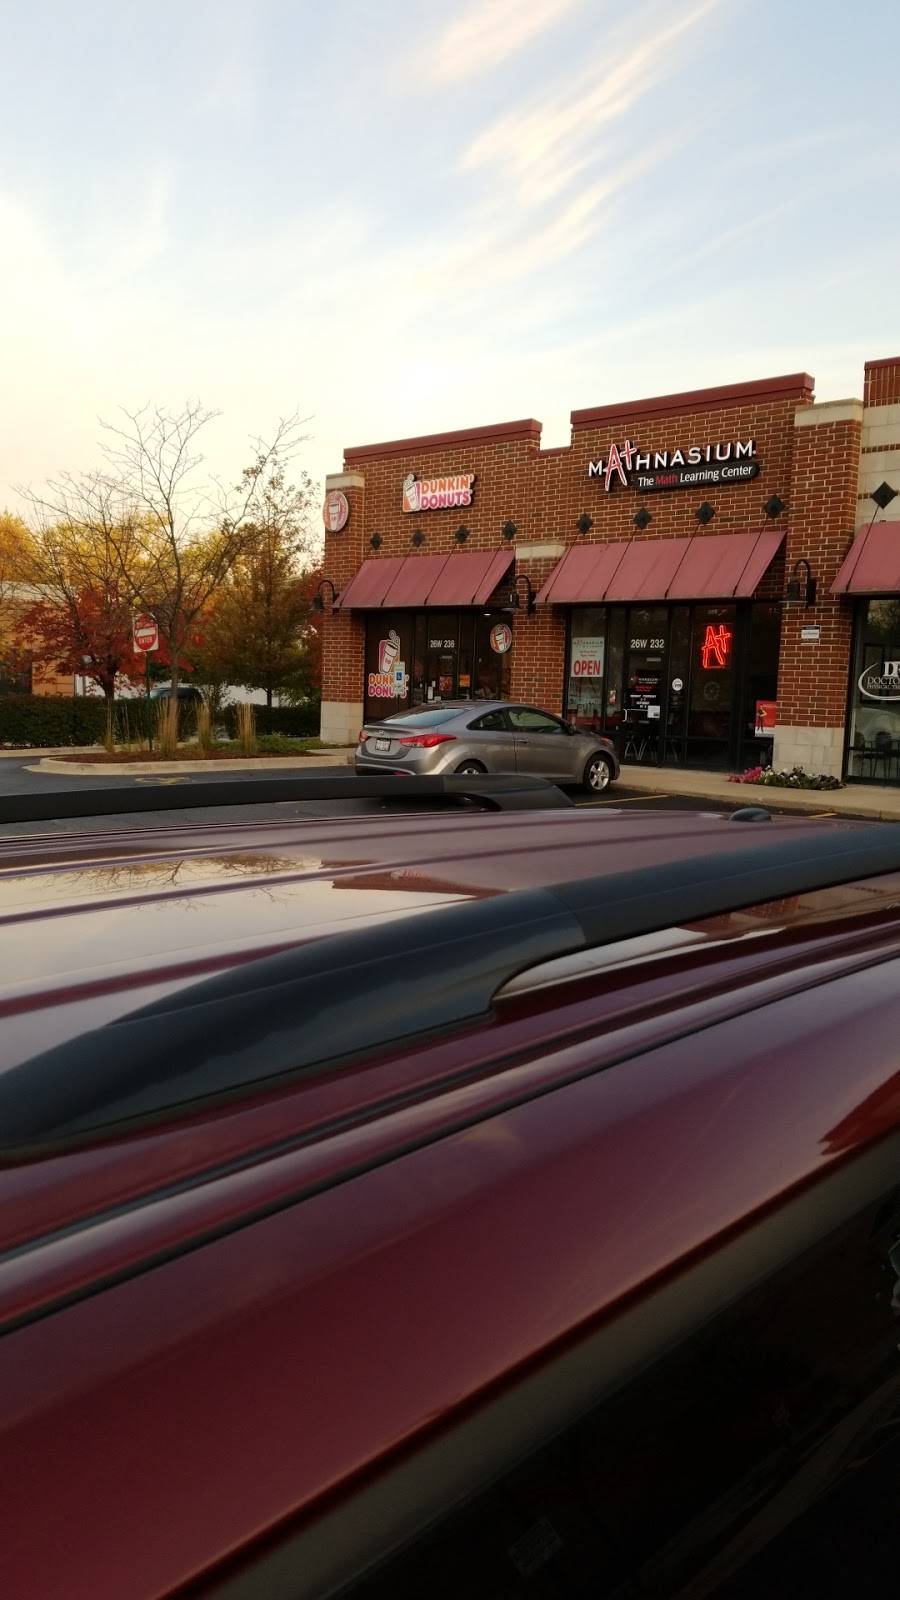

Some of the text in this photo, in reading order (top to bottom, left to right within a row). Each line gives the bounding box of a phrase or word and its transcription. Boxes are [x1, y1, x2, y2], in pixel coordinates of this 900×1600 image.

[637, 465, 753, 487] The Math Learning Center
[421, 491, 470, 508] DONUTS
[630, 639, 664, 649] 26W 232
[573, 660, 601, 676] OPEN
